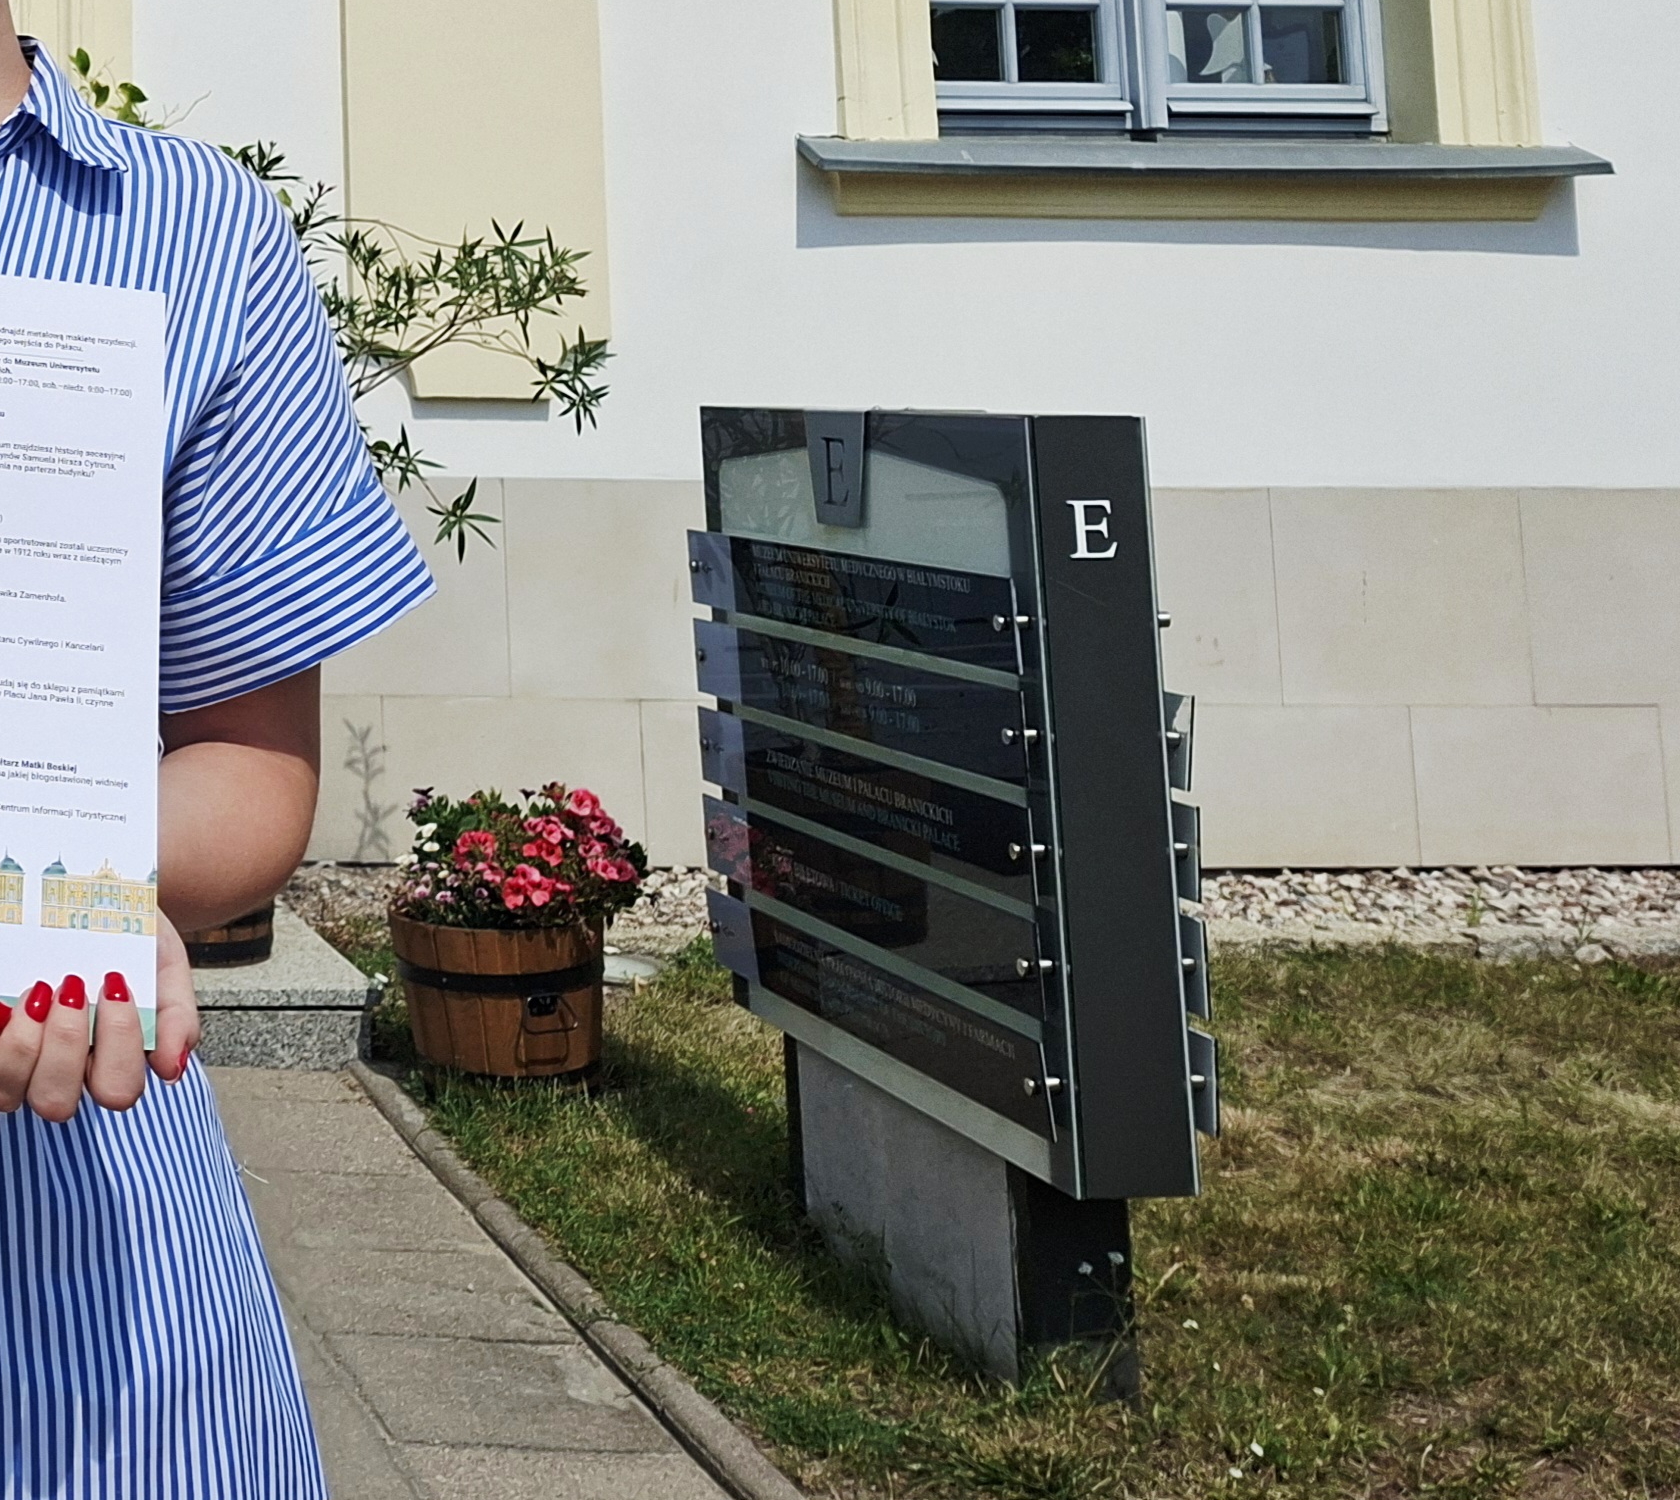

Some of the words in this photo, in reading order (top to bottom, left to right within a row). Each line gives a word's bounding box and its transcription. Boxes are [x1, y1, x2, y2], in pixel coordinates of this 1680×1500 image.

[14, 357, 47, 367] Muzeum
[49, 361, 100, 374] Uniwersytetu
[820, 436, 851, 505] E
[1065, 499, 1118, 560] E
